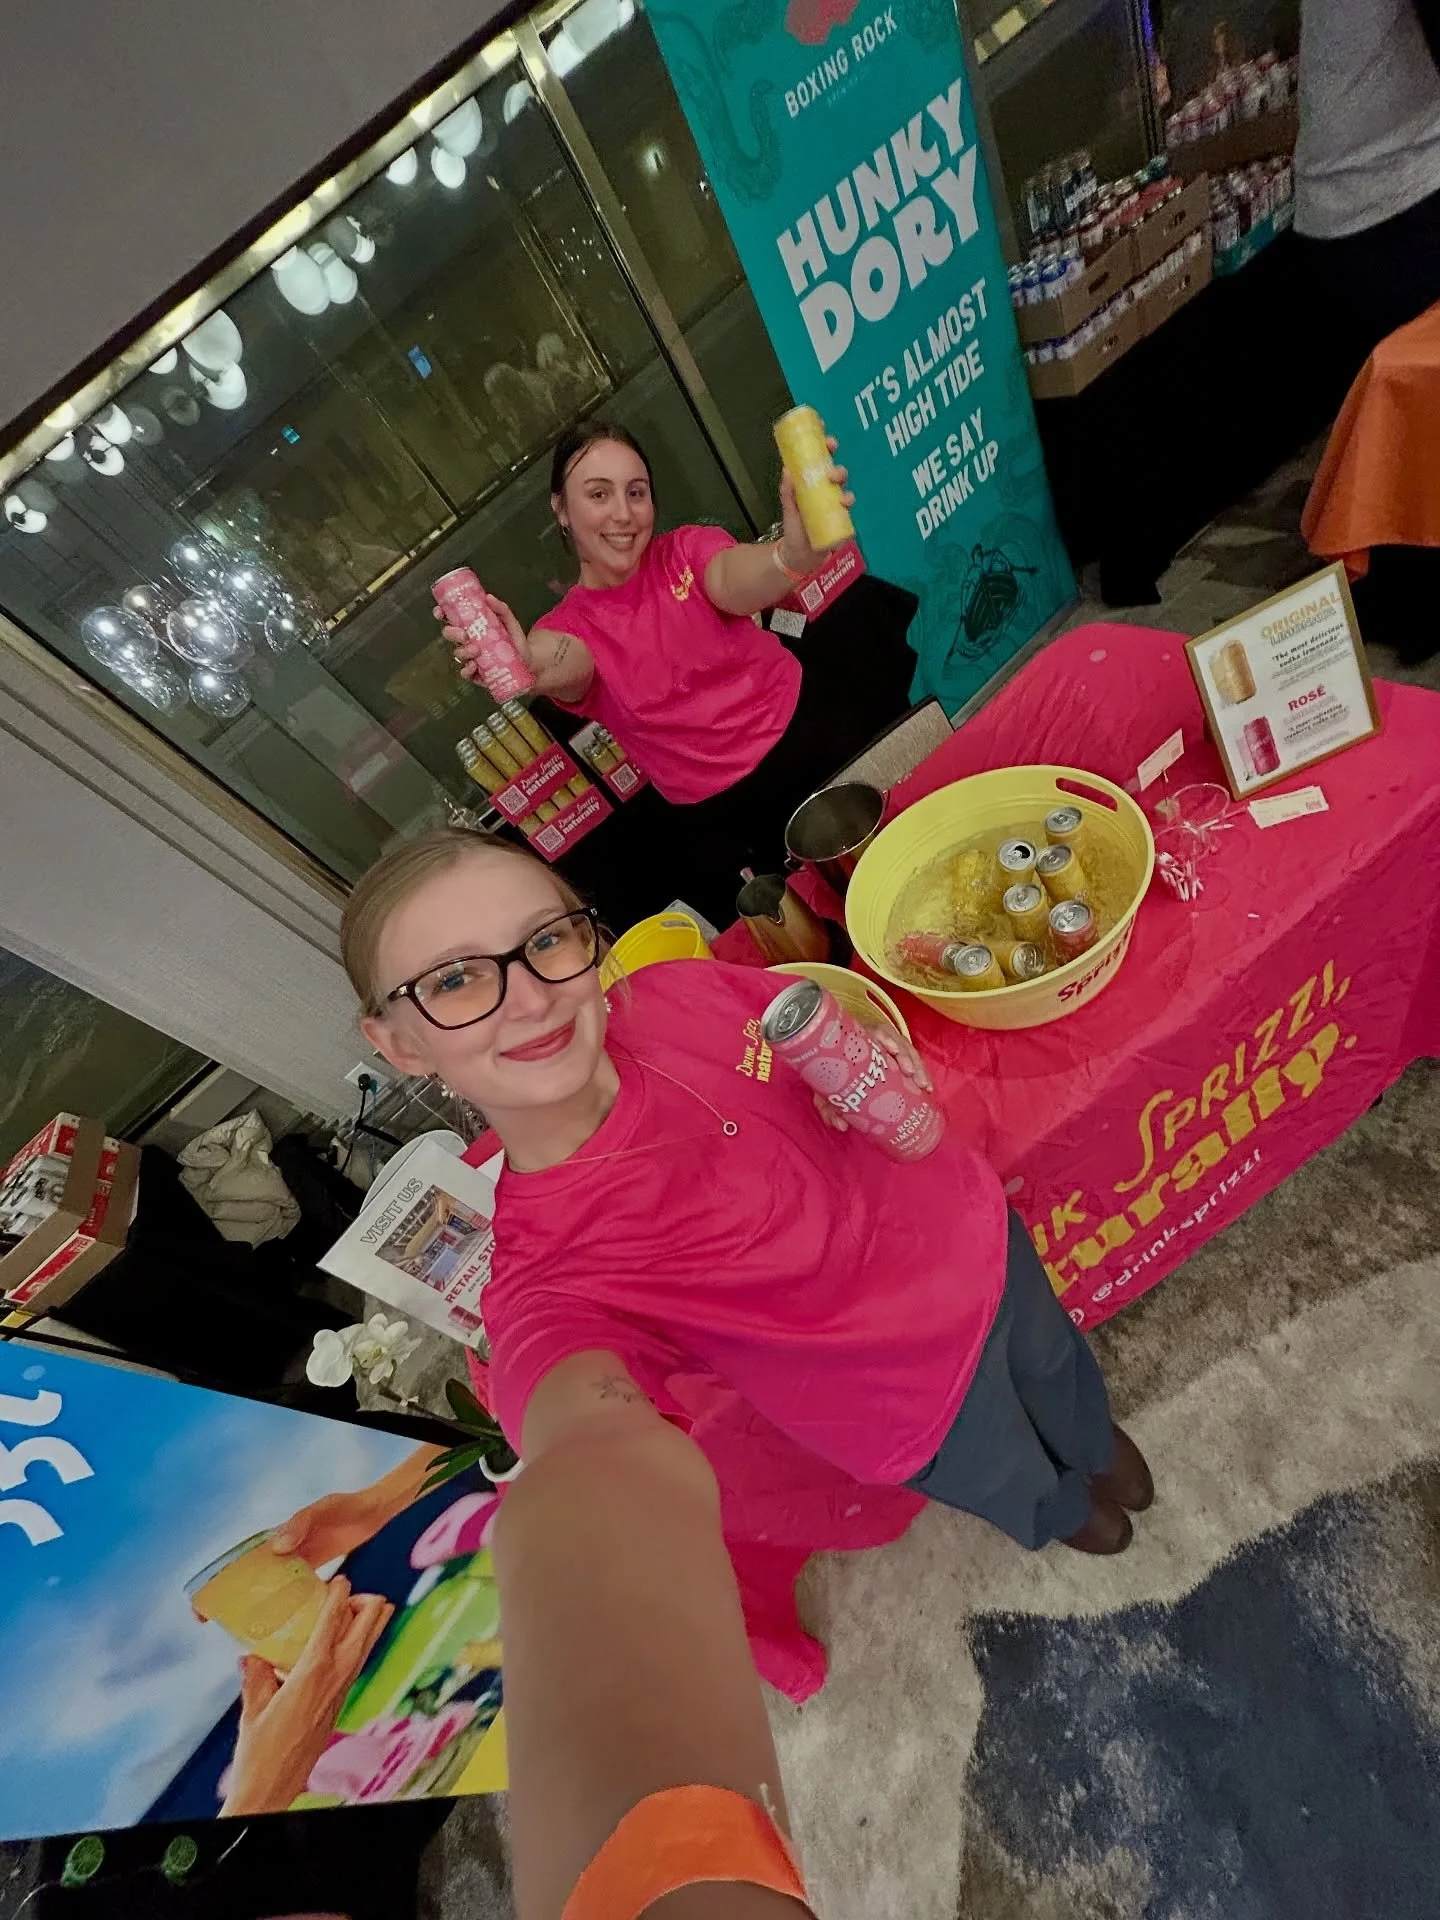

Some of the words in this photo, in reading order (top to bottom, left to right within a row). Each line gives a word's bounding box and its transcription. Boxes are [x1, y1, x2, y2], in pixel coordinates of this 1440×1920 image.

[785, 47, 849, 118] BOXING
[851, 4, 898, 62] ROCK
[776, 77, 963, 297] HUNKY
[798, 145, 980, 374] DORY
[854, 366, 901, 431] IT'S
[903, 277, 988, 390] ALMOST
[884, 385, 937, 457] HIGH
[934, 339, 985, 408] TIDE
[912, 446, 948, 499] WE
[946, 407, 985, 467] SAY
[915, 464, 975, 541] DRINK
[973, 440, 999, 483] UP
[1262, 591, 1342, 638] ORIGINAL
[827, 1037, 889, 1113] Sprizzi
[360, 1199, 403, 1244] VISIT
[396, 1177, 423, 1203] US
[444, 1264, 481, 1304] RETAIL
